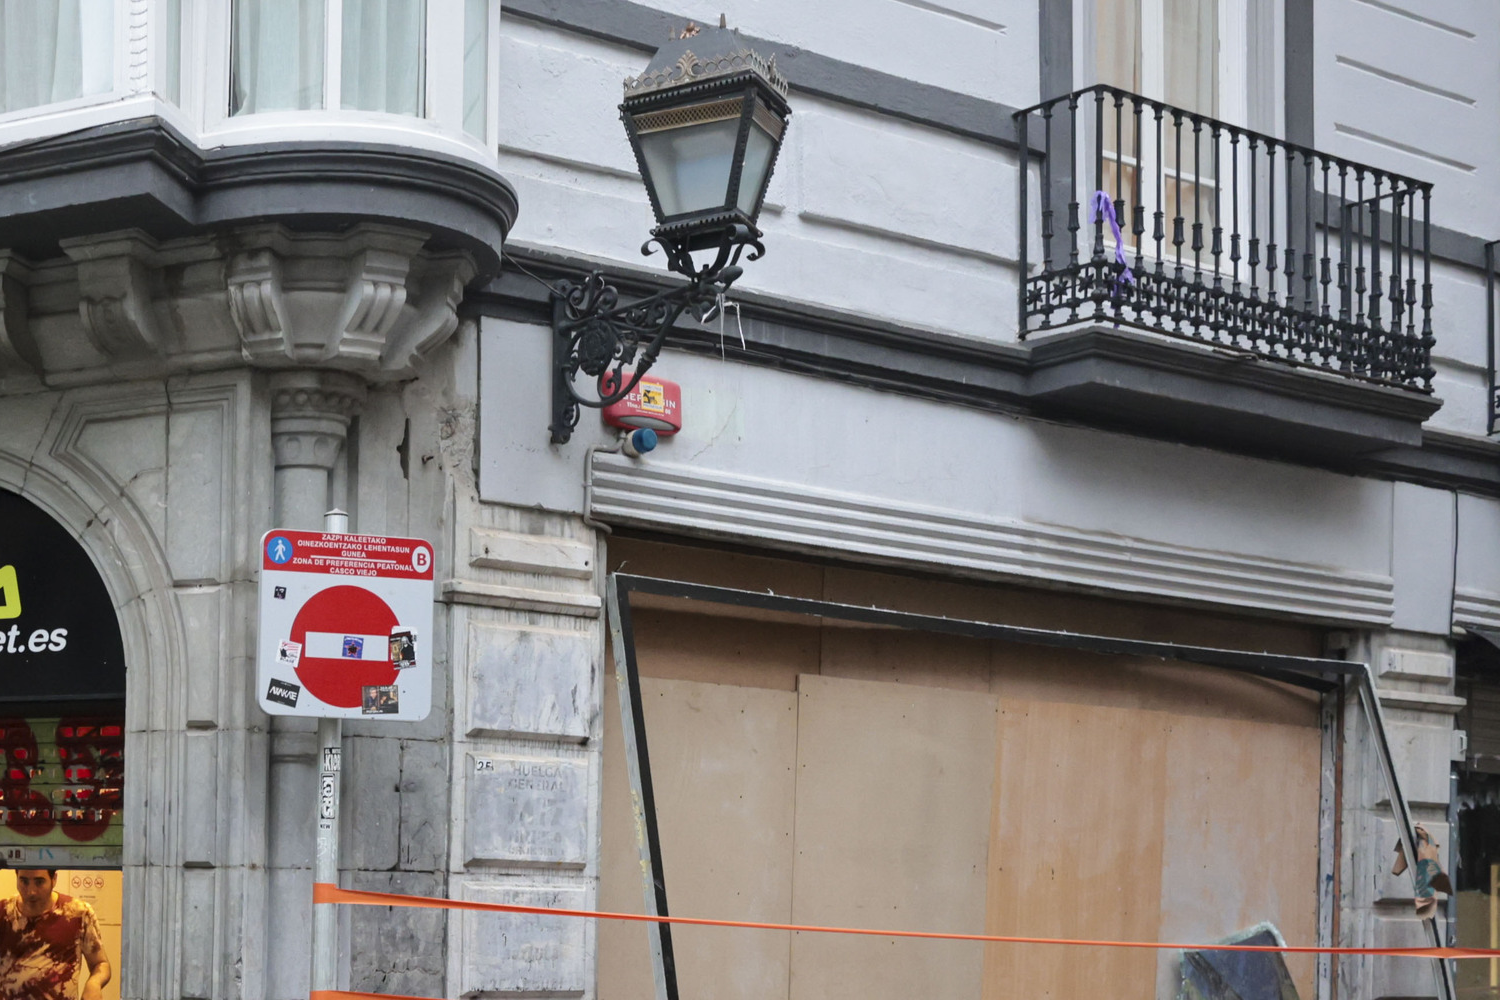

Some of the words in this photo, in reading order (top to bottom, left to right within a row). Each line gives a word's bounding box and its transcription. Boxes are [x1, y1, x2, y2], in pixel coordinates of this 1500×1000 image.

[322, 533, 342, 541] ZAZPI
[344, 535, 386, 544] KALEETAKO
[297, 540, 362, 550] OINEZKOENTZAKO
[364, 544, 410, 553] LEHENTASUN
[341, 550, 366, 558] GUNEA
[417, 553, 427, 566] B
[293, 557, 312, 565] ZONA
[326, 559, 375, 569] PREFERENCIA
[377, 562, 414, 572] PEATONAL
[330, 567, 354, 575] CASCO
[513, 764, 562, 778] HUELGA
